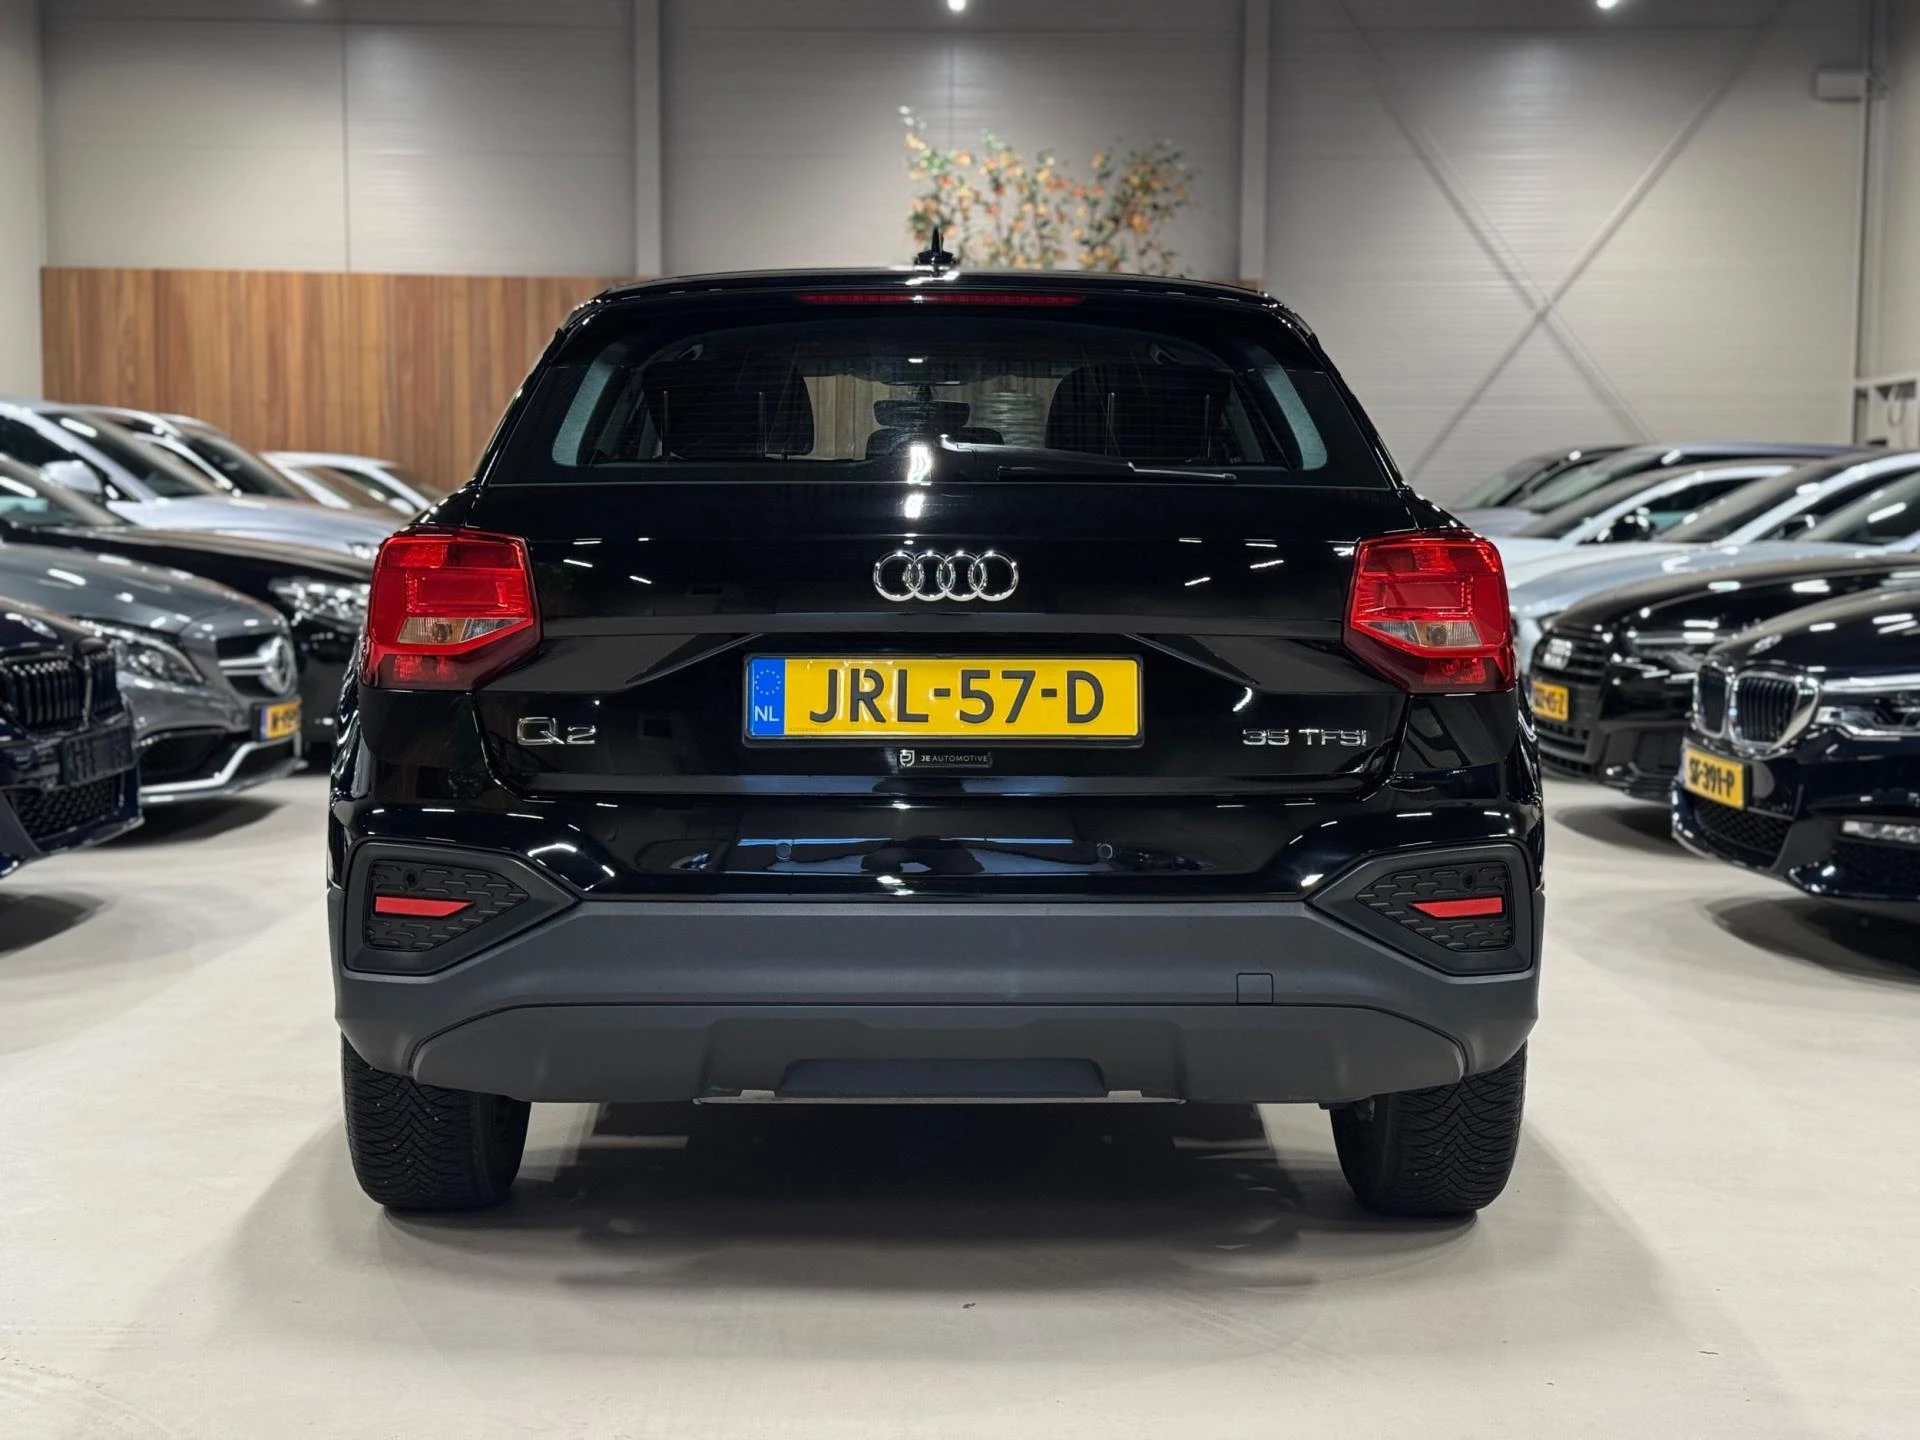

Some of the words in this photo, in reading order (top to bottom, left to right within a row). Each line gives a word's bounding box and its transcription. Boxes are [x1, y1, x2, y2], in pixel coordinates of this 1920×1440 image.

[808, 668, 1105, 724] JRL-57-D
[754, 705, 780, 722] NL
[516, 716, 597, 746] Q2
[1242, 729, 1290, 746] 35
[1298, 729, 1367, 747] TFSI
[920, 754, 930, 762] JE
[931, 754, 989, 762] AUTOMOTIVE
